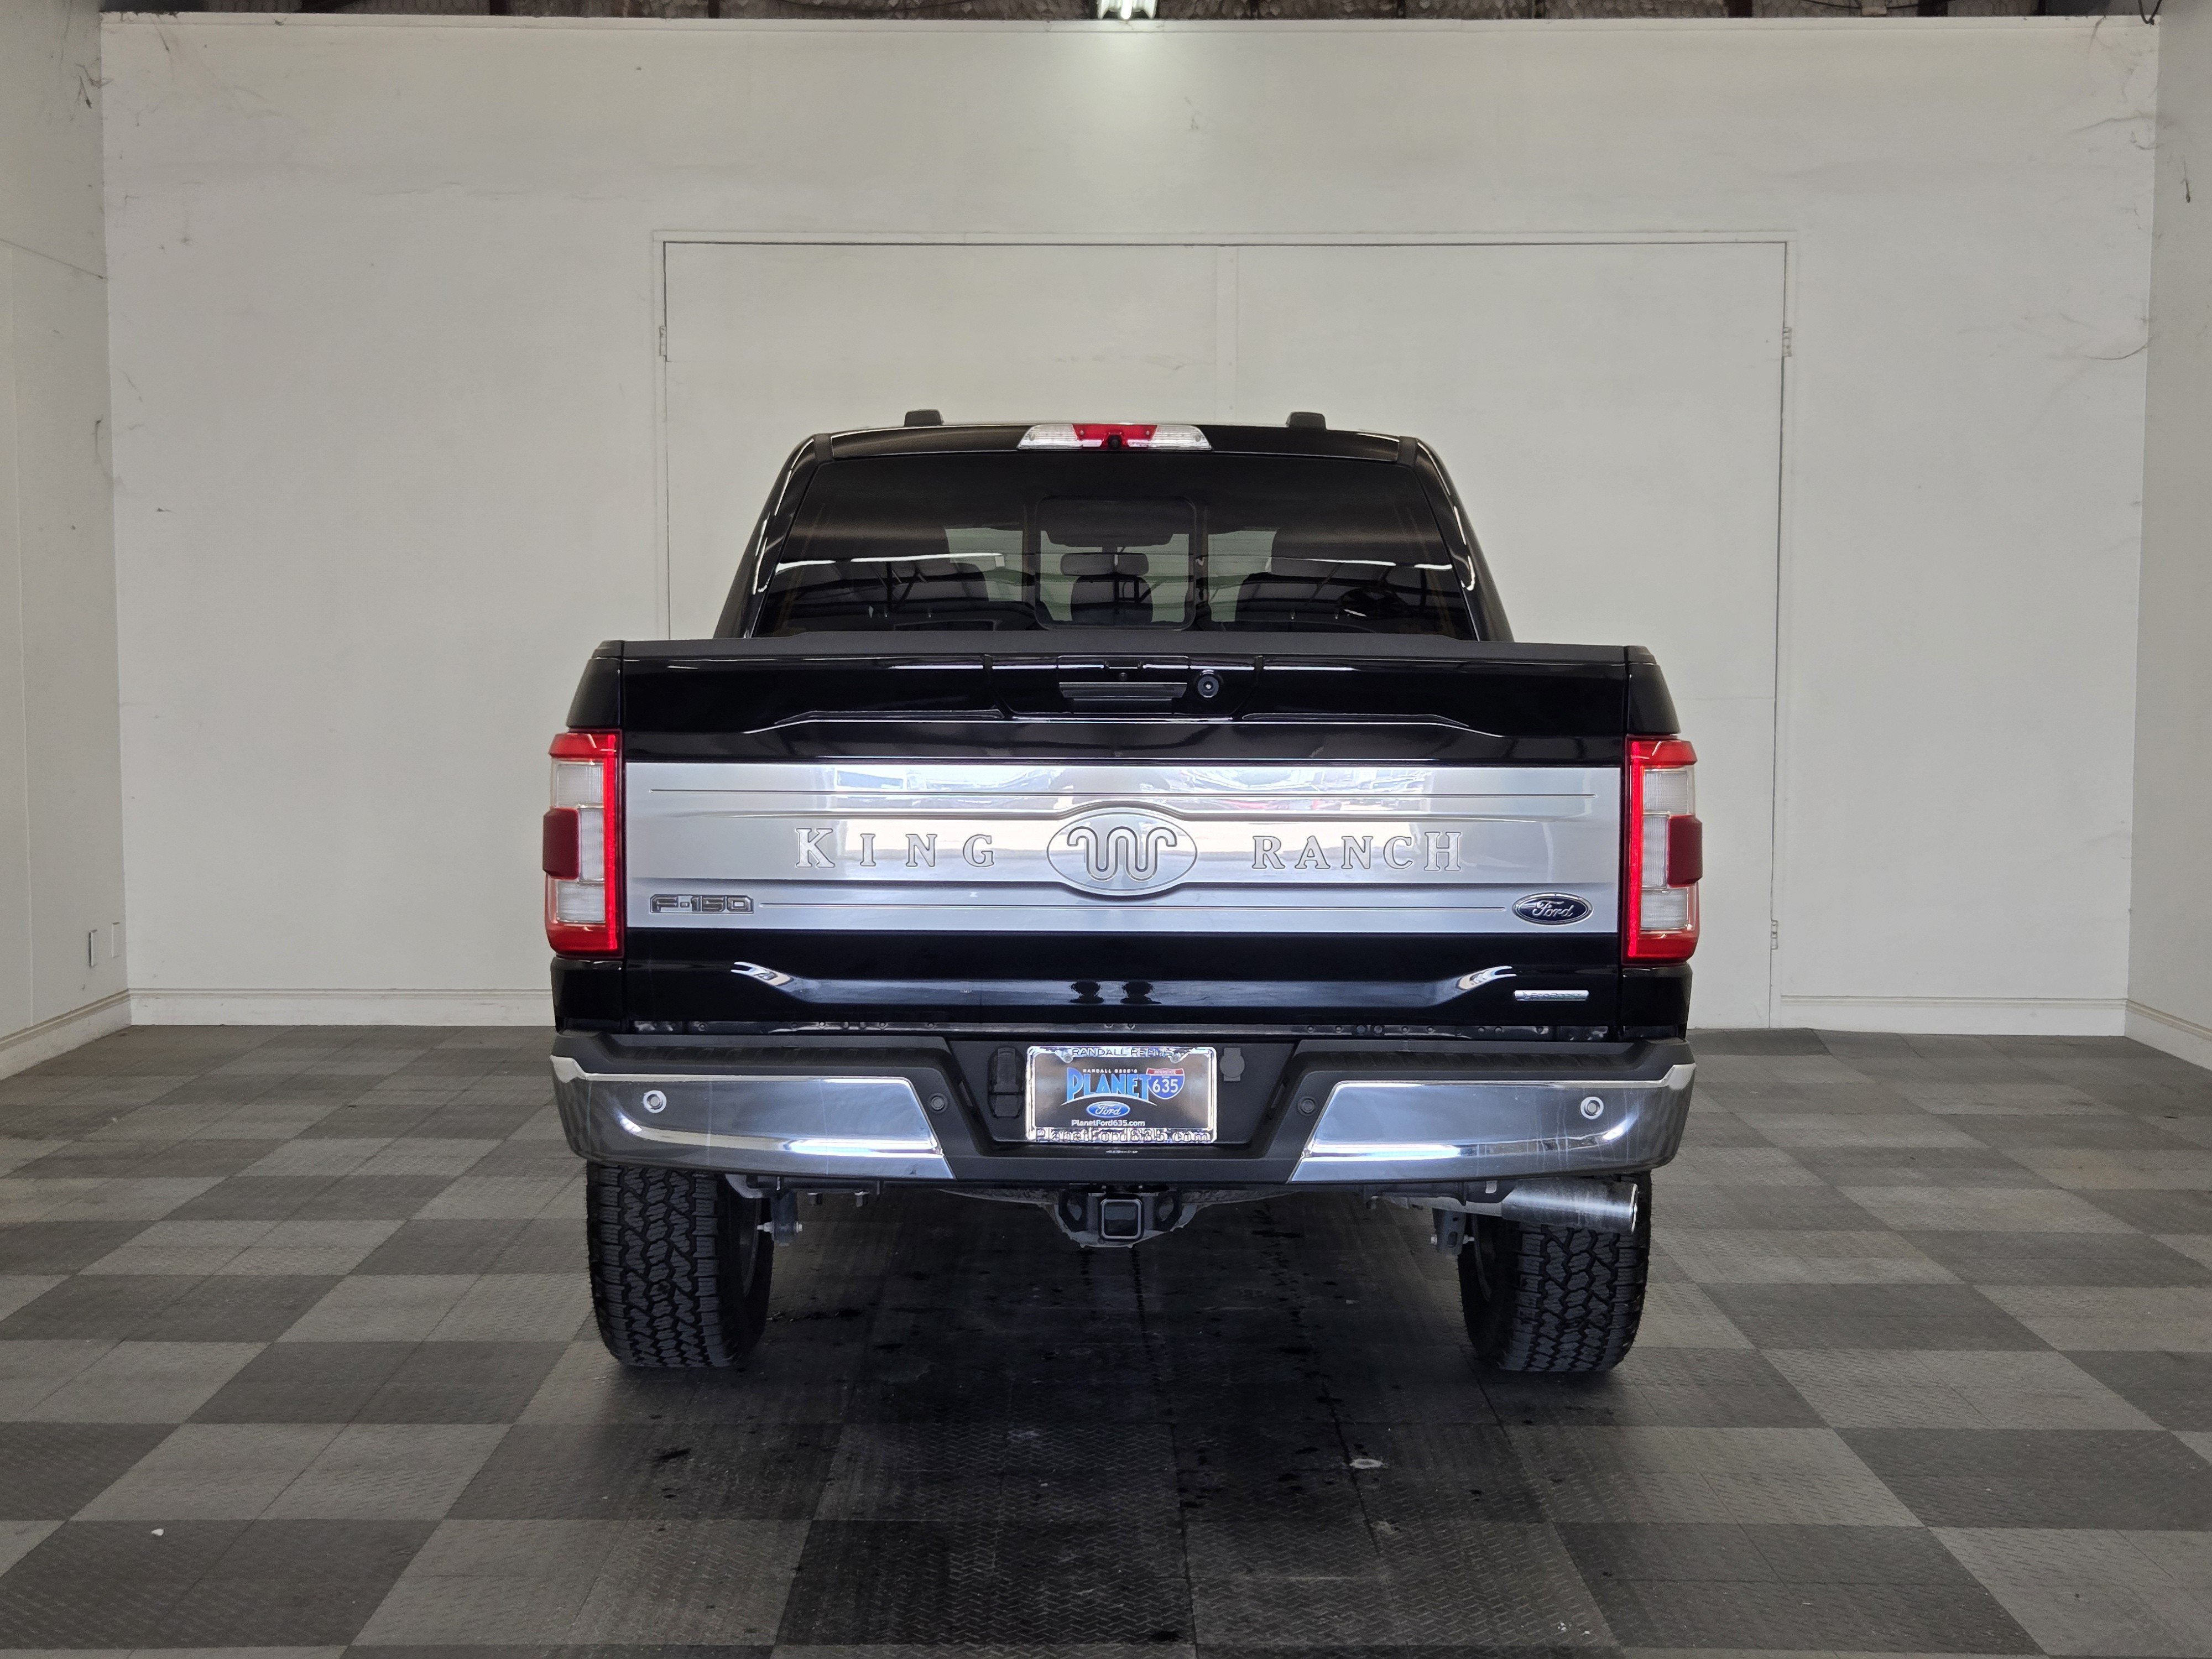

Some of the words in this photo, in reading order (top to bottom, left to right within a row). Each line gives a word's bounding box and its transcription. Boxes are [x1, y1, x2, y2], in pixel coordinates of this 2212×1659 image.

[795, 828, 995, 868] KING
[1252, 831, 1463, 872] RANCH
[651, 894, 754, 914] F-150
[1532, 900, 1574, 917] Ford
[1072, 1048, 1126, 1056] RANDALL
[1067, 1067, 1151, 1102] PLANET
[1152, 1079, 1178, 1093] 635
[1095, 1103, 1121, 1115] Ford
